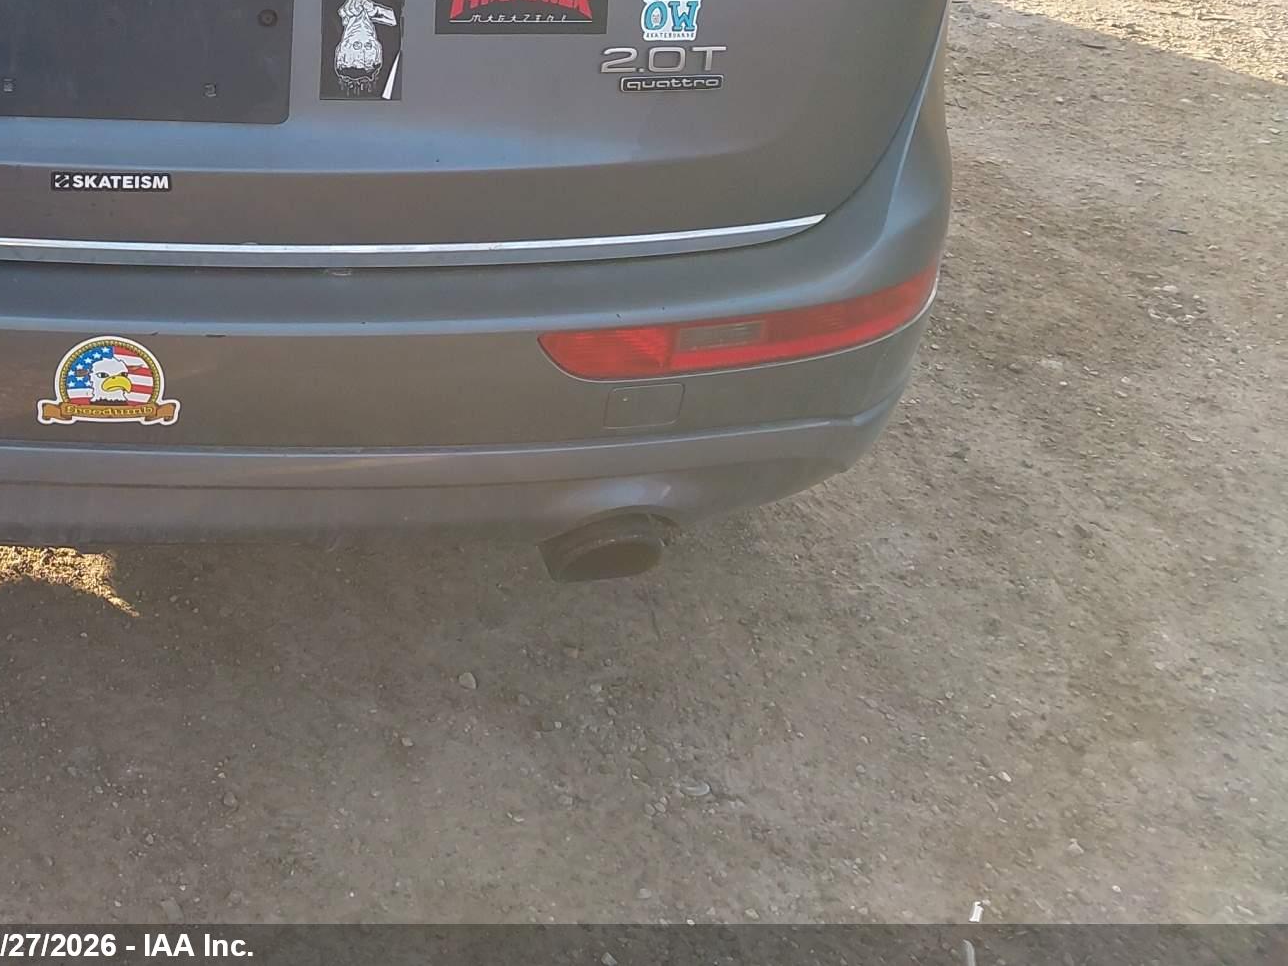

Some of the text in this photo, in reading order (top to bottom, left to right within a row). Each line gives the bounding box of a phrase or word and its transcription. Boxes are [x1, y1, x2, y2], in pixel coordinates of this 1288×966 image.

[600, 46, 727, 73] 2.0T
[626, 78, 719, 91] quattro
[72, 175, 169, 189] SKATEISM
